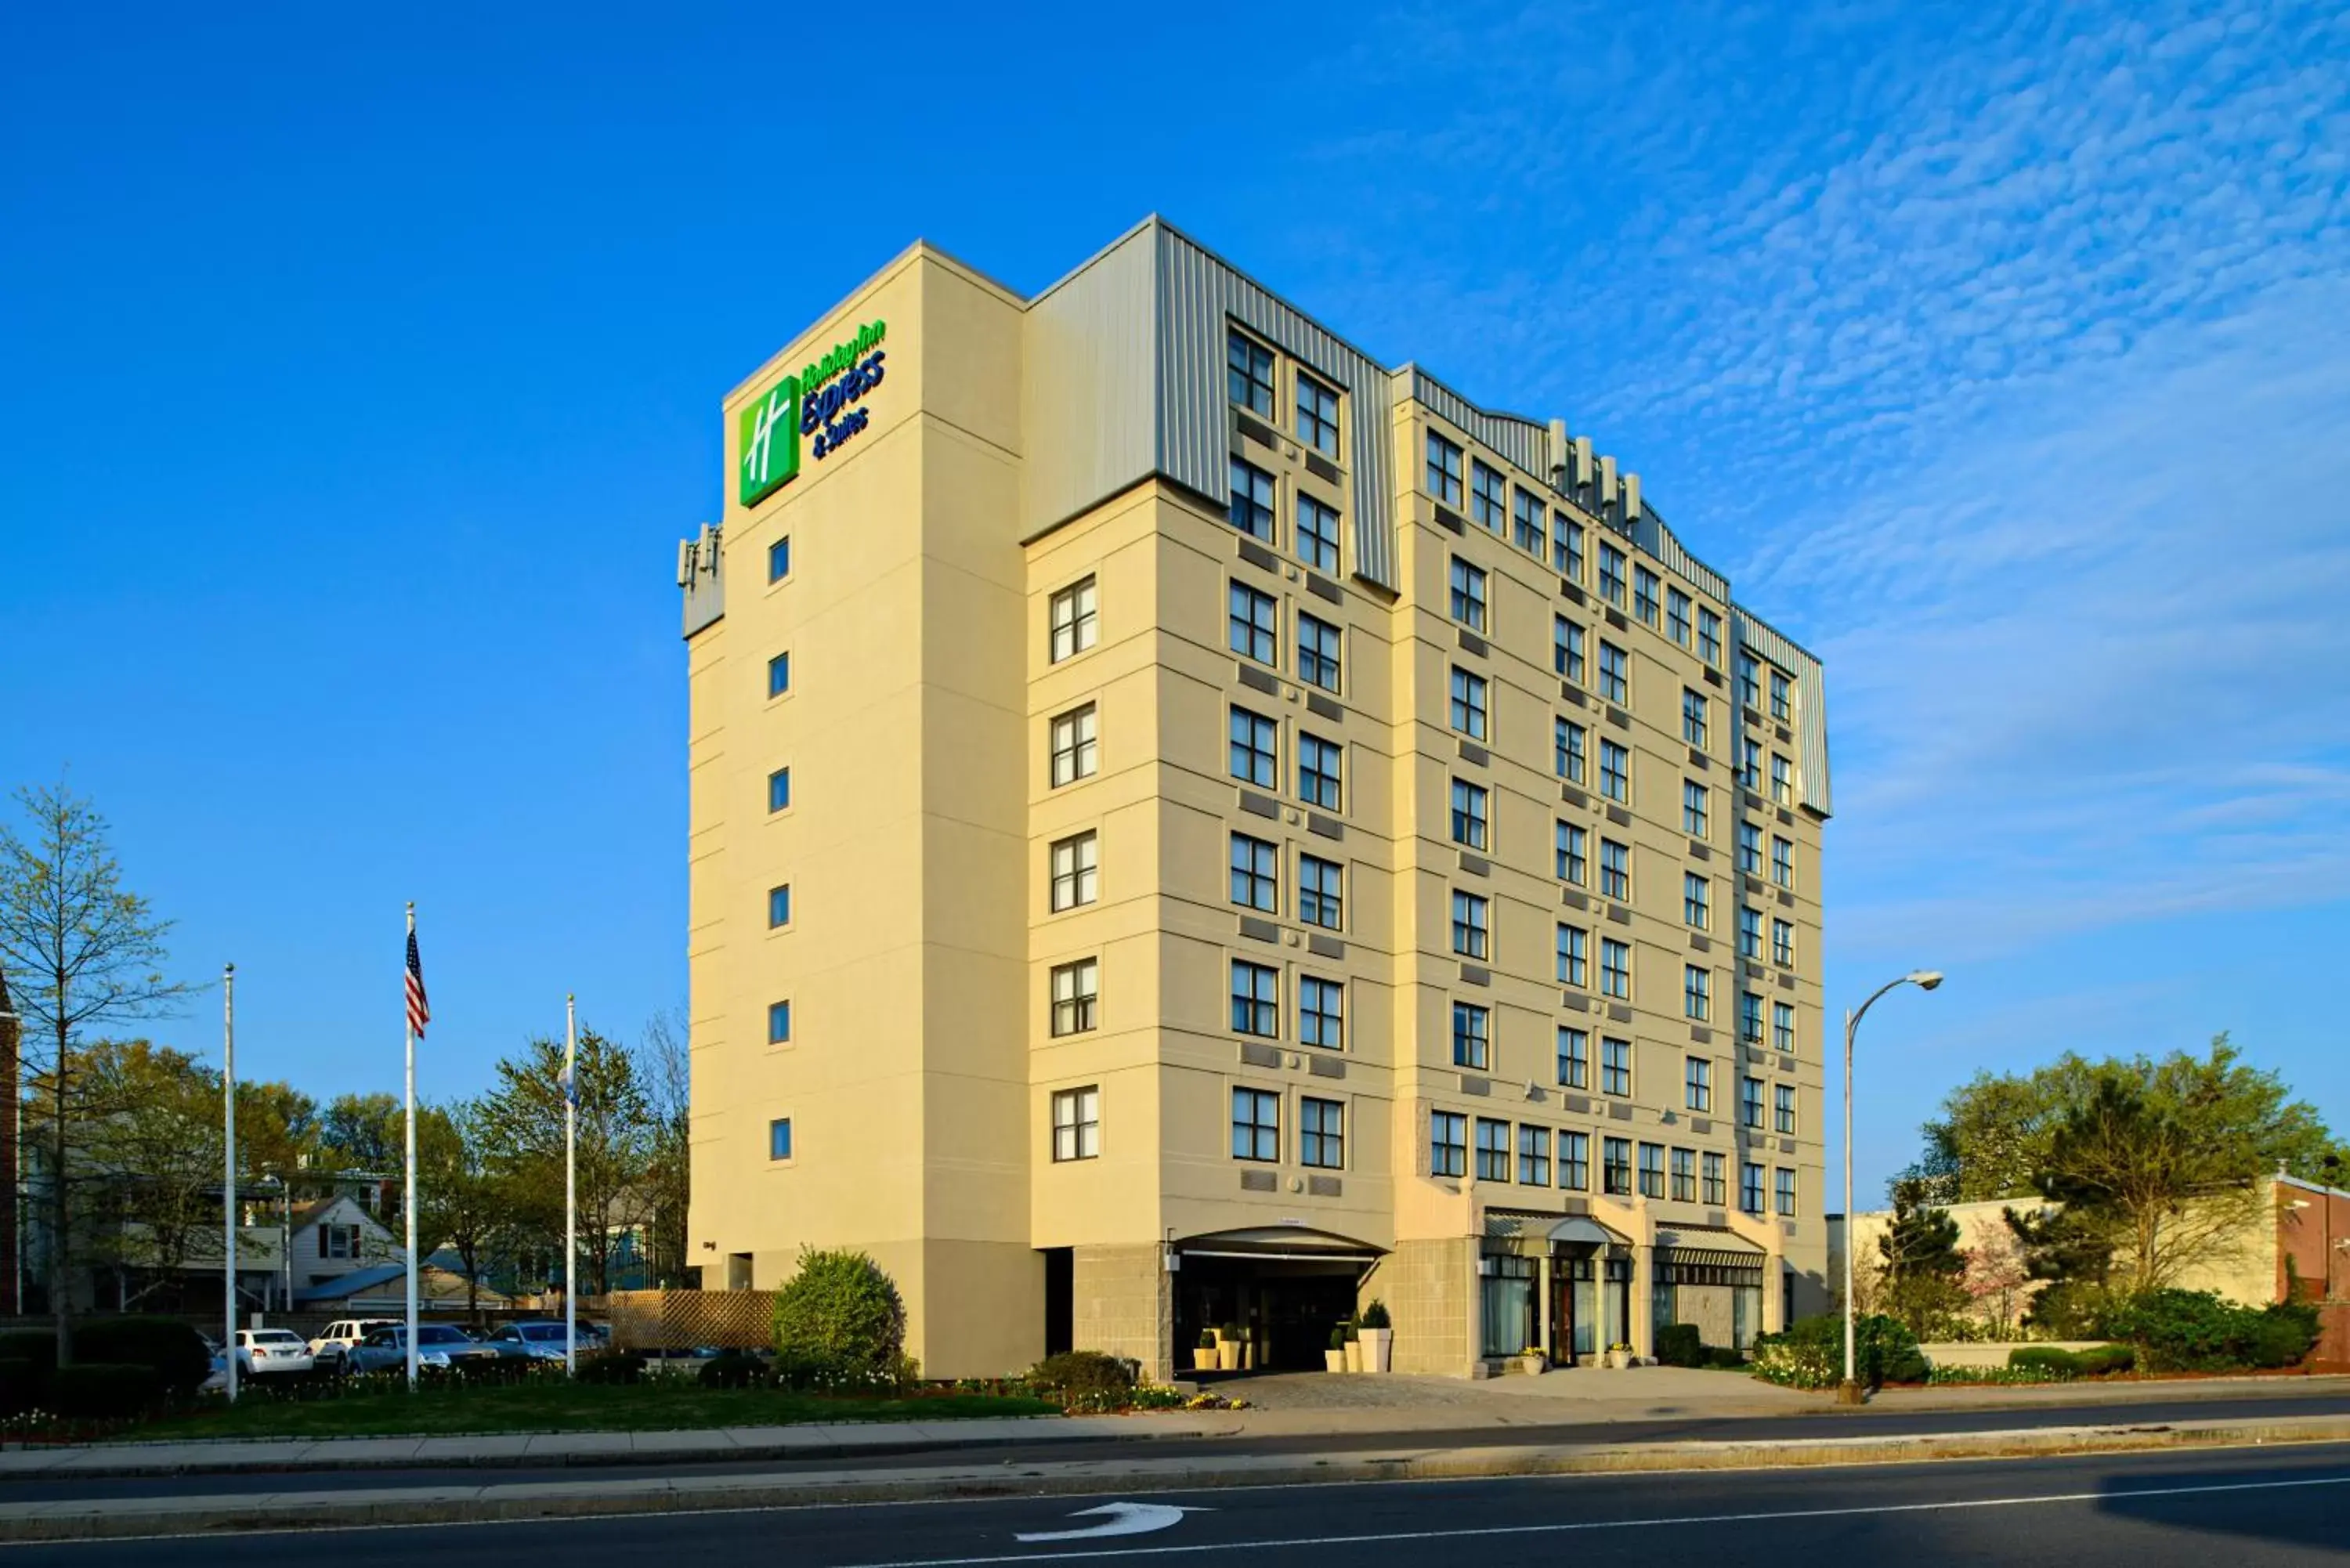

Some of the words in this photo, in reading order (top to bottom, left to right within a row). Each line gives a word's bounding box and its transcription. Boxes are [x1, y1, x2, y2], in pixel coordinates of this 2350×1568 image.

[801, 338, 859, 396] Holiday
[859, 320, 885, 353] Inn
[801, 351, 885, 436] Express
[813, 433, 827, 461] &
[825, 407, 869, 453] Suites
